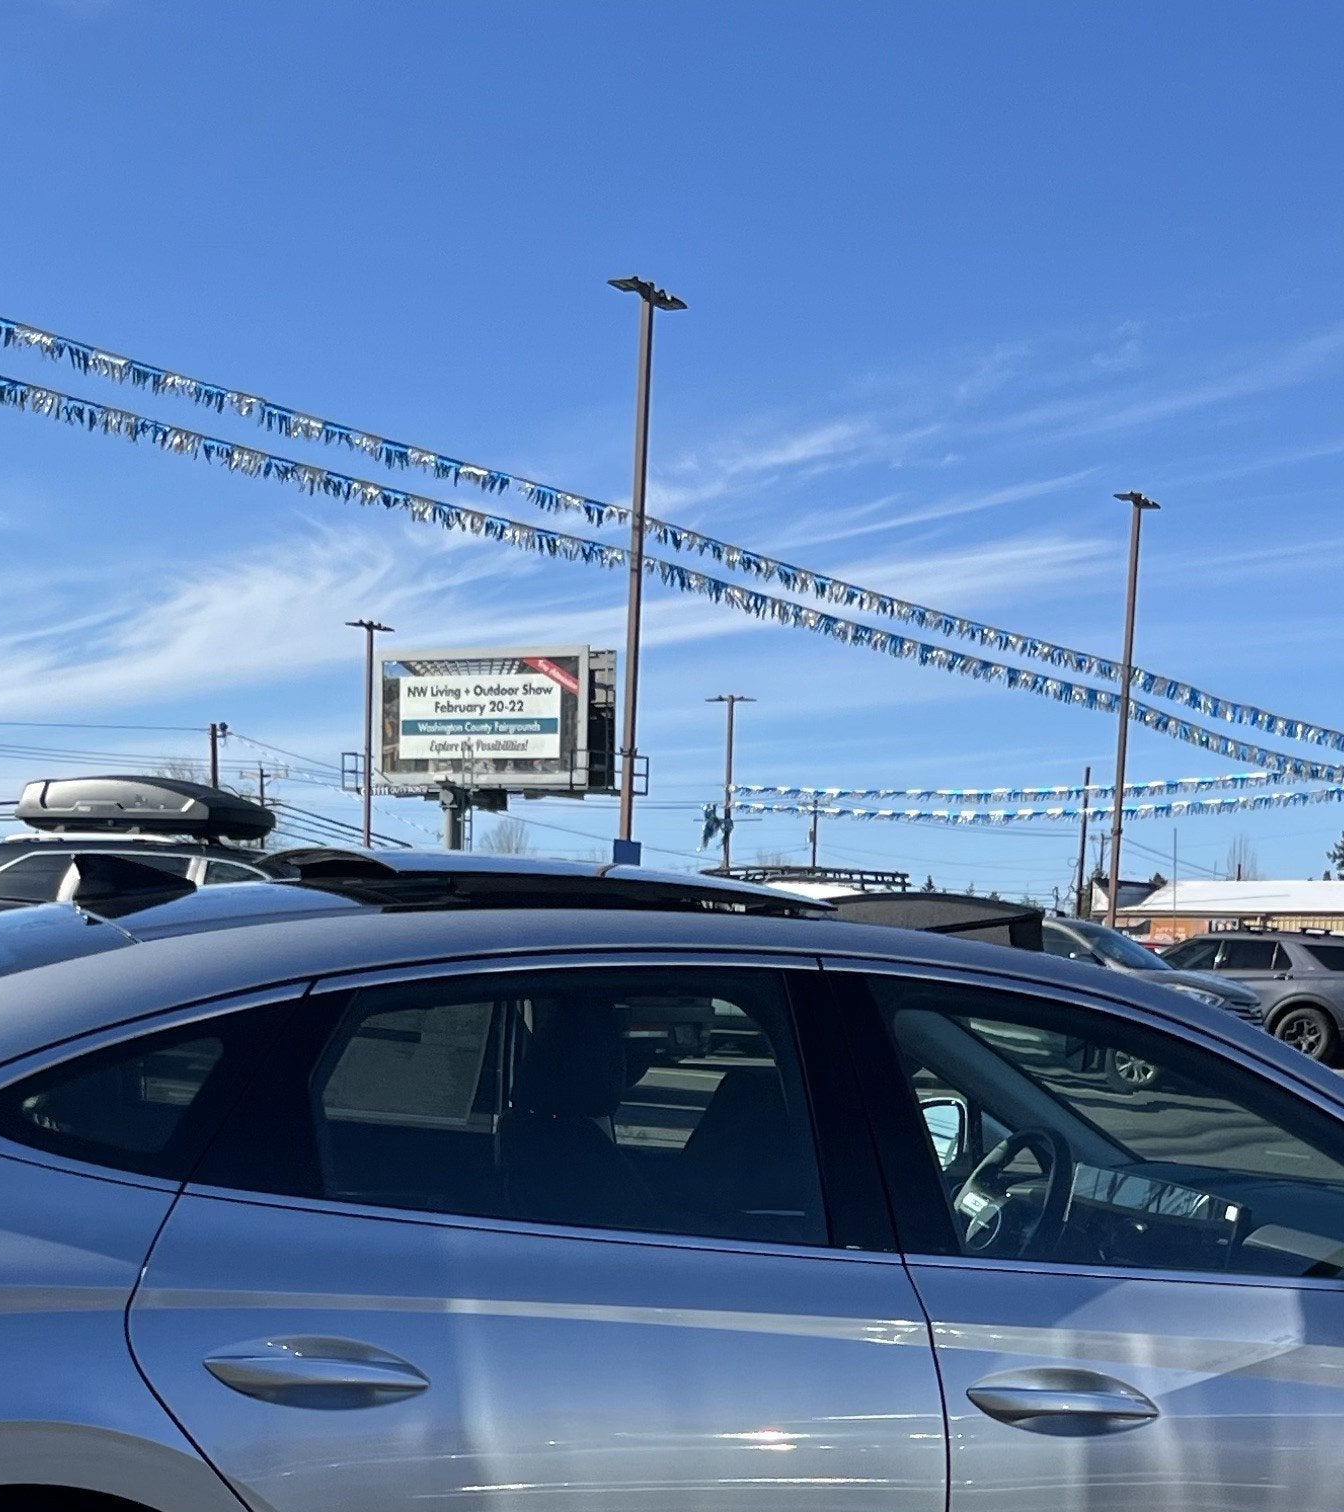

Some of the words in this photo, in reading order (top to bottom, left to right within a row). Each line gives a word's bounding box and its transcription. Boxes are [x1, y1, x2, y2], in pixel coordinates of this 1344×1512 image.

[407, 686, 427, 697] NW
[431, 685, 461, 700] Living
[473, 684, 519, 696] Outdoor
[522, 683, 553, 695] Show
[435, 701, 485, 716] February
[489, 700, 524, 712] 20-22
